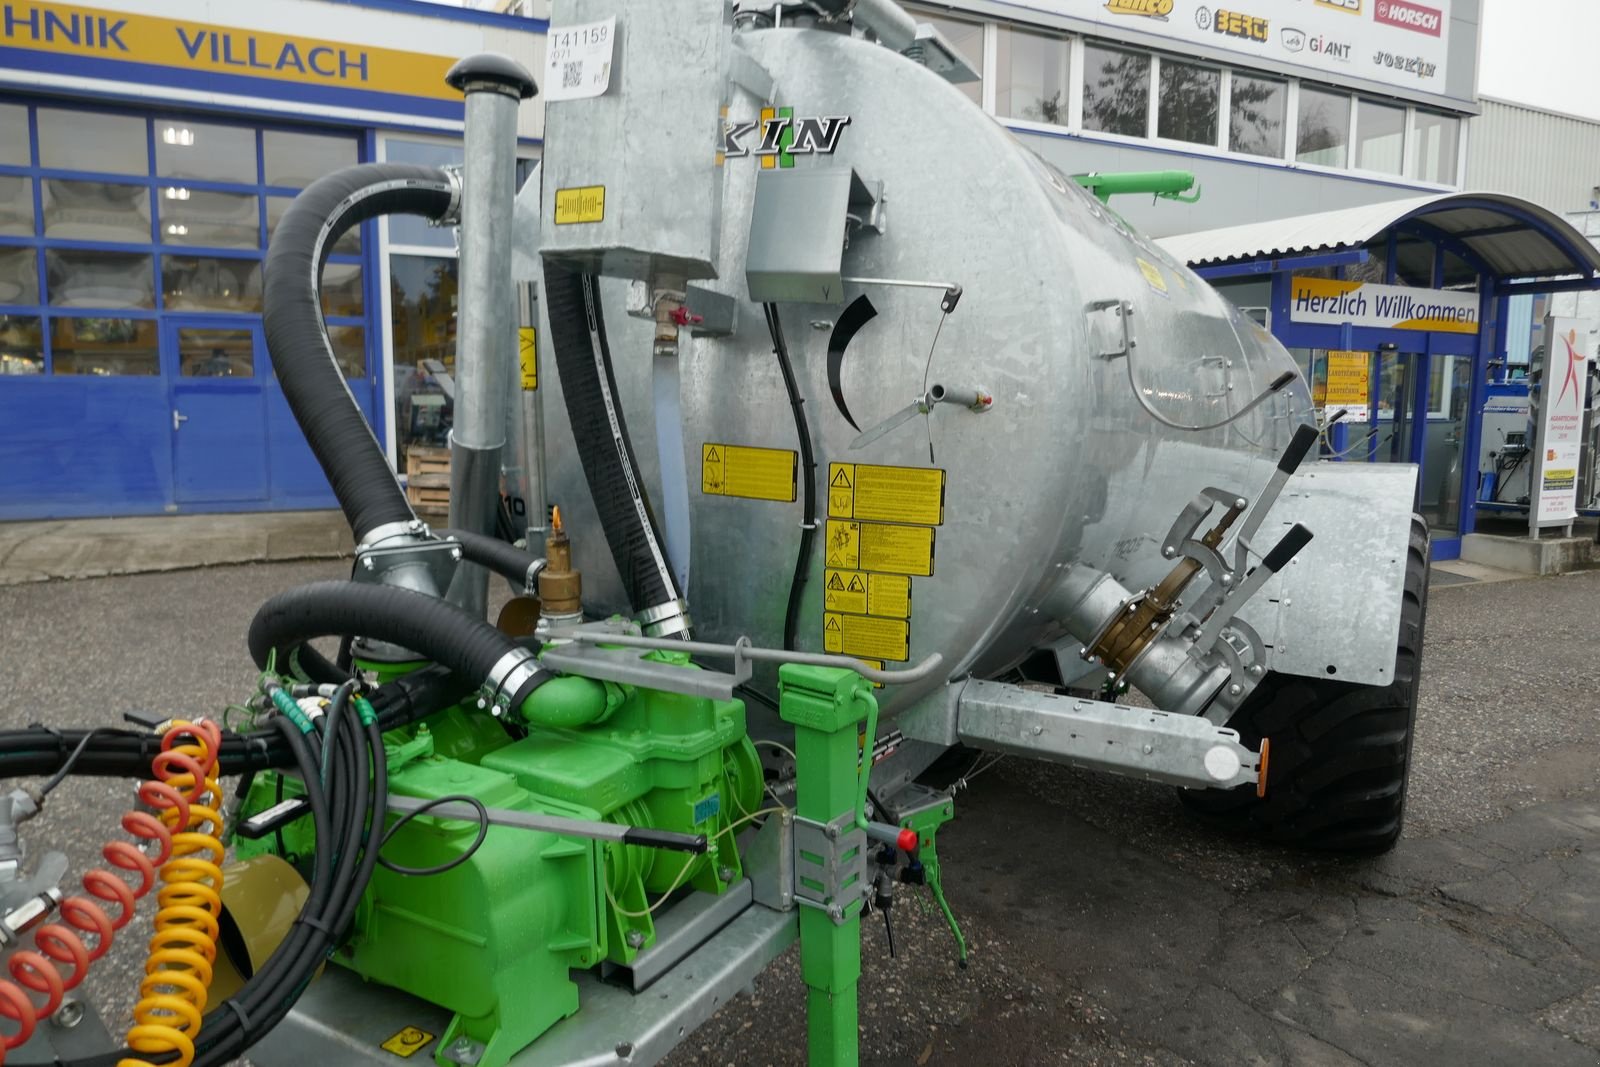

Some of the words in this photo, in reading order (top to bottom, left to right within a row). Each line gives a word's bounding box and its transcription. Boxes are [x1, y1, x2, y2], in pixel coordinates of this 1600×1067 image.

[1388, 4, 1439, 30] HORSCH
[4, 5, 129, 51] HNIK
[175, 26, 369, 82] VILLACH
[552, 25, 608, 49] T41159
[1373, 51, 1436, 78] JOSKIN
[1296, 288, 1367, 317] Herzlich
[1375, 294, 1476, 324] Willkommen
